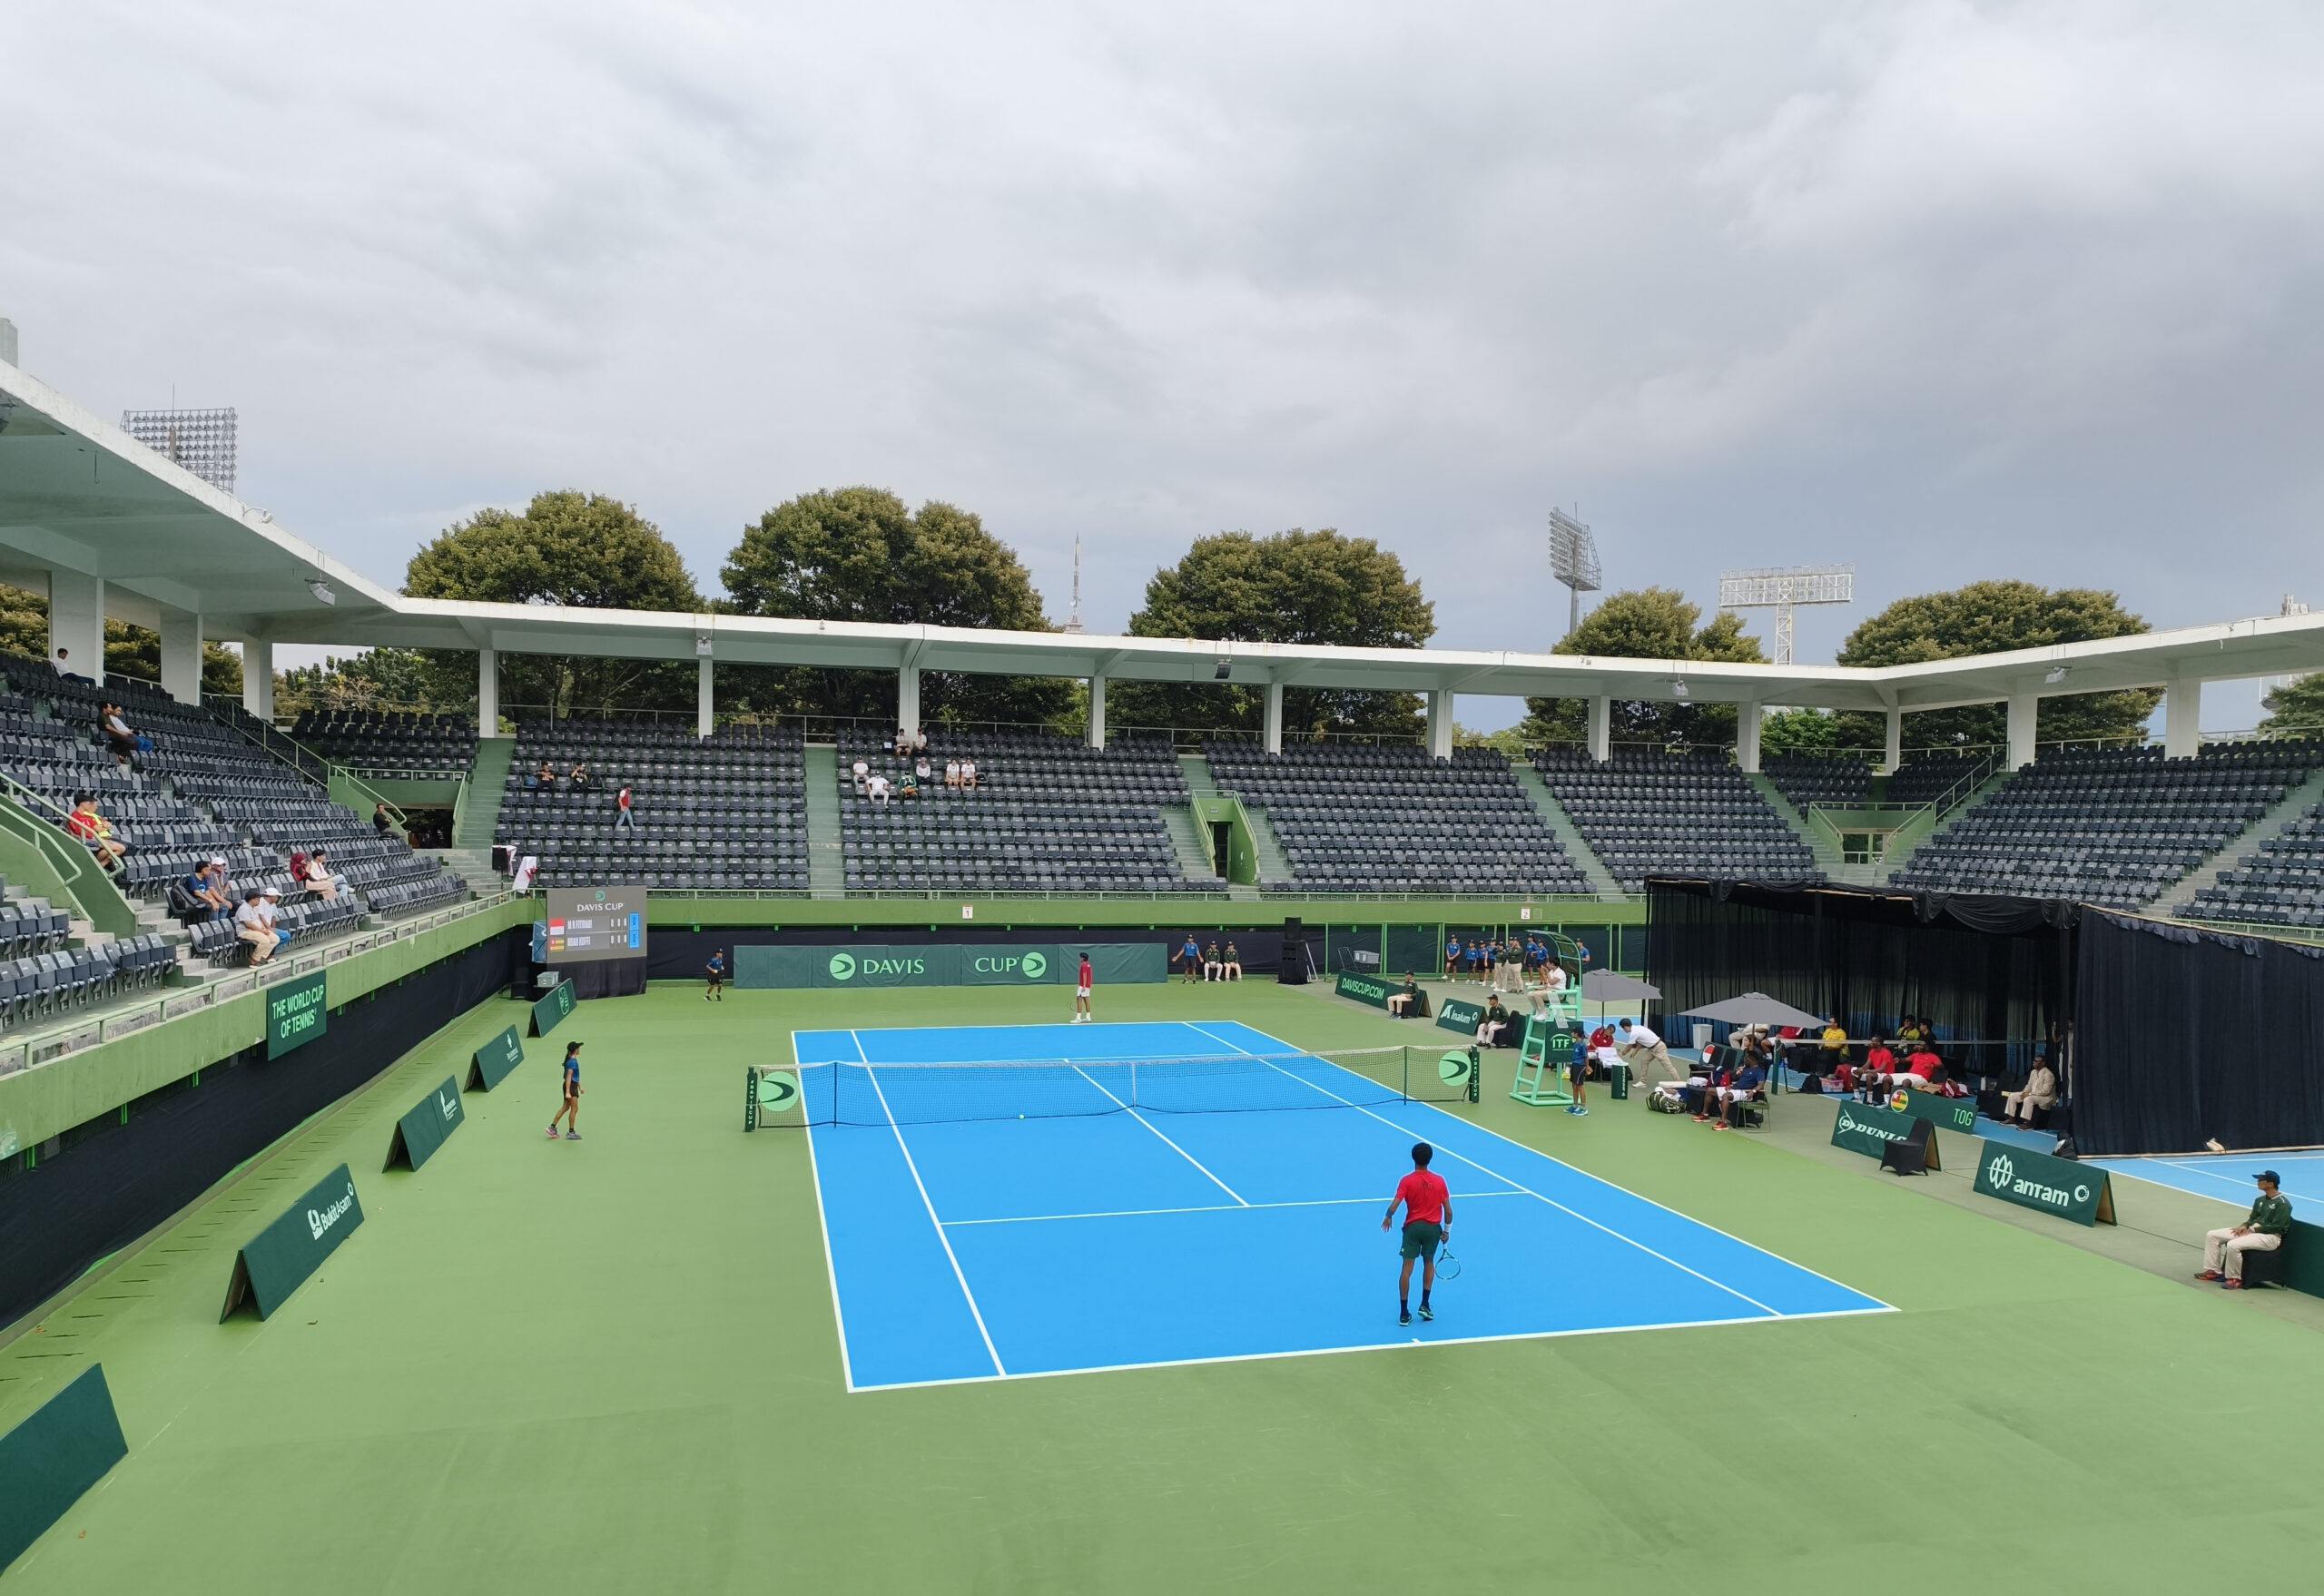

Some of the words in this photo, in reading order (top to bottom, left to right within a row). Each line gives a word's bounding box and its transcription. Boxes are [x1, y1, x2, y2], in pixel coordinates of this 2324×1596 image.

[576, 903, 603, 912] DAVIS
[605, 902, 624, 911] CUP
[863, 959, 925, 974] DAVIS
[974, 957, 1018, 972] CUP
[1341, 977, 1385, 1000] DAVISCUP.COM
[272, 999, 286, 1020] THE
[287, 990, 310, 1013] WORLD
[311, 984, 324, 1004] CUP
[281, 1019, 291, 1039] OF
[1552, 1039, 1571, 1049] ITF
[1953, 1108, 1974, 1127] TOG
[1854, 1123, 1907, 1141] DUNL
